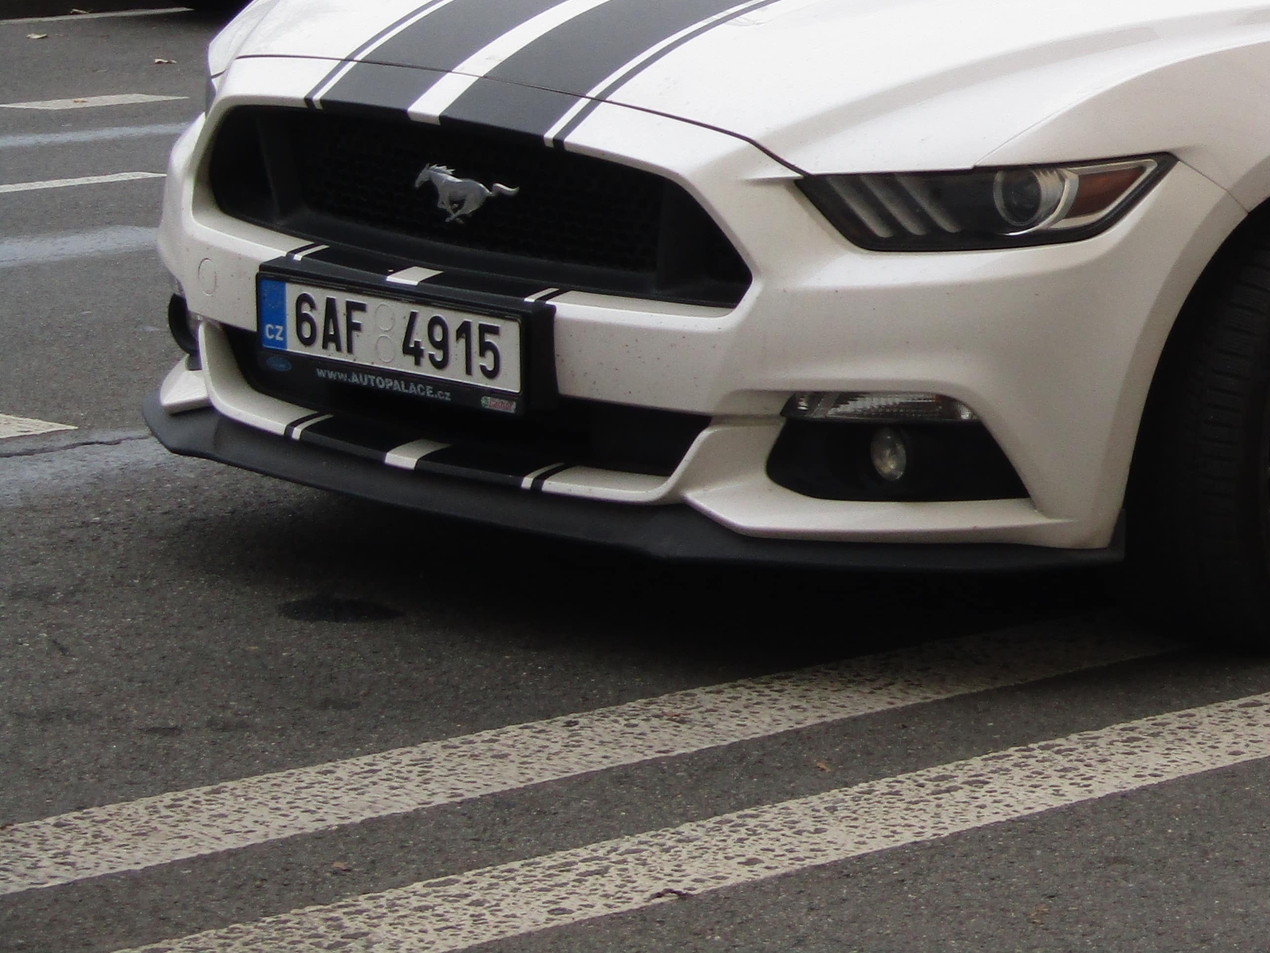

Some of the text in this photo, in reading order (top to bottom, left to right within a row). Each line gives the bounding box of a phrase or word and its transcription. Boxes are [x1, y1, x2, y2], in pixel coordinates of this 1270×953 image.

[265, 324, 284, 341] CZ
[295, 291, 501, 379] 6AF 4915
